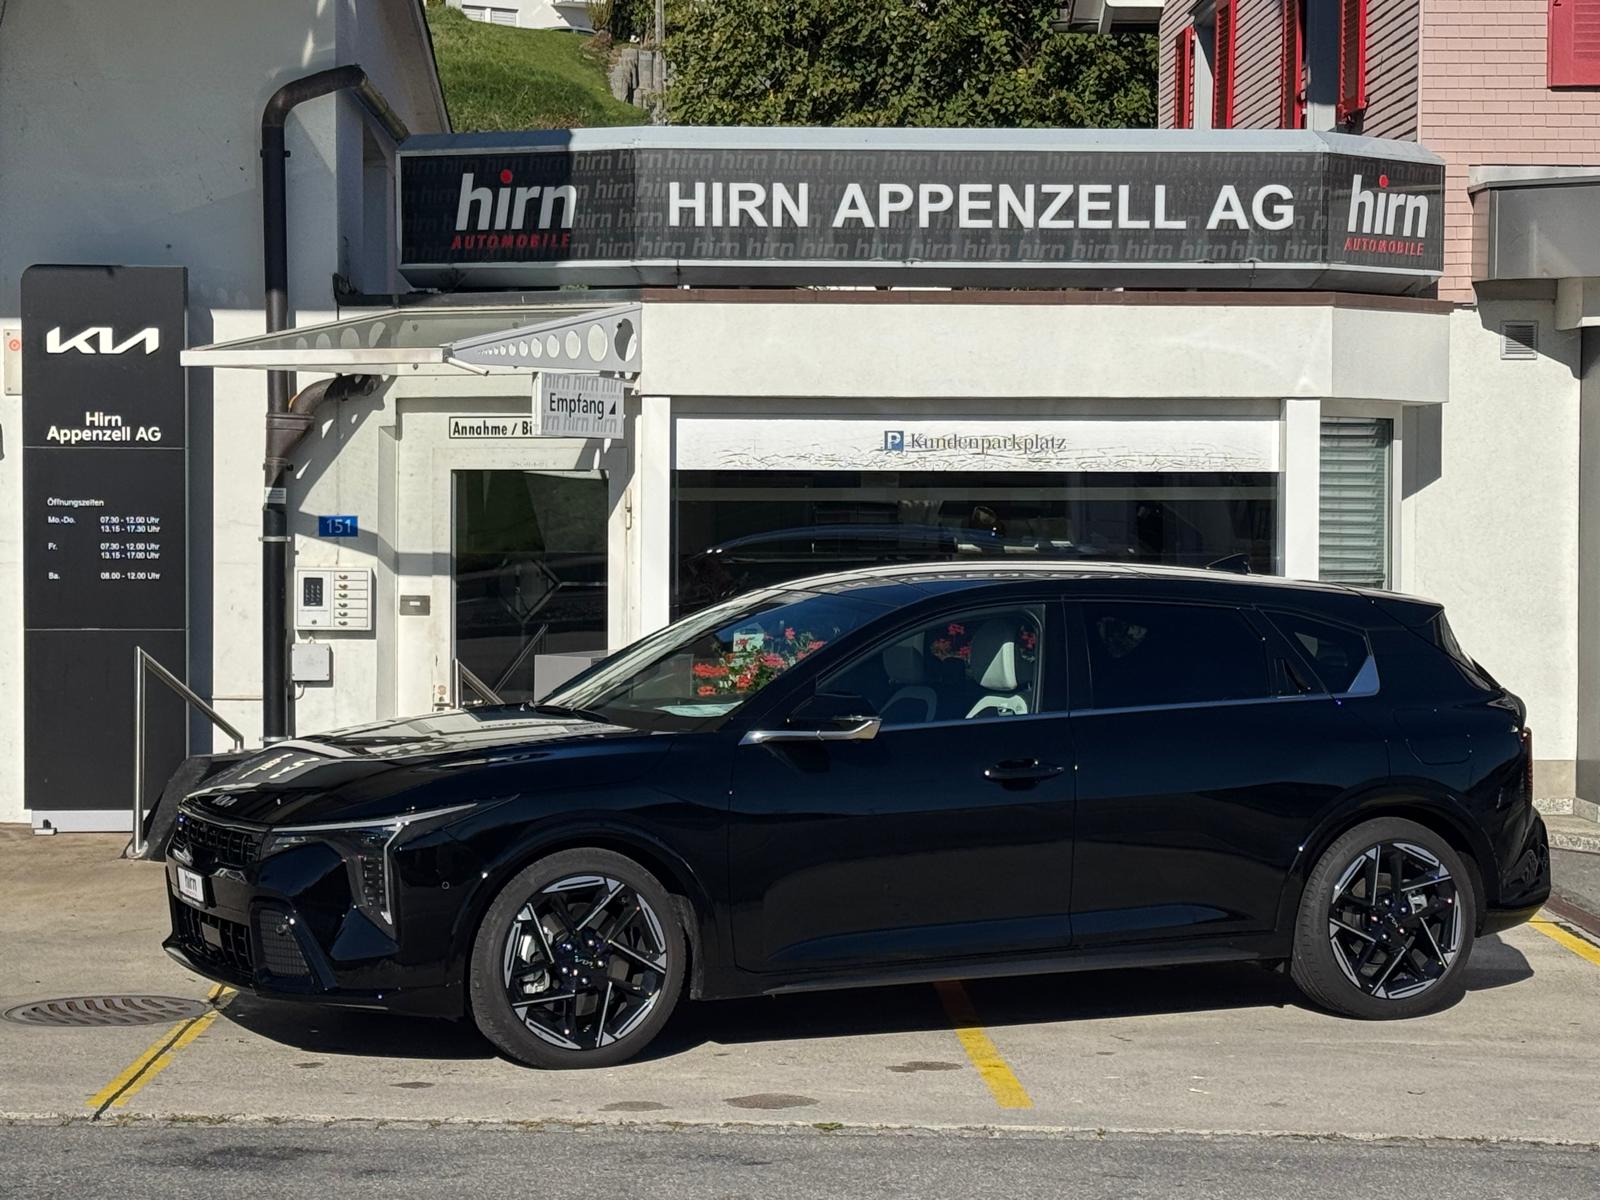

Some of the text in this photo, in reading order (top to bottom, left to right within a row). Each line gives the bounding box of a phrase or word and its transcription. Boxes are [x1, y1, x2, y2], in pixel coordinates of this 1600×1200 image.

[720, 151, 769, 169] hirn
[775, 151, 824, 169] hirn
[455, 169, 577, 231] hirn
[668, 181, 809, 228] HIRN
[832, 182, 1188, 230] APPENZELL
[1205, 184, 1295, 231] AG
[1347, 174, 1429, 238] hirn
[451, 232, 570, 250] AUTOMOBILE
[692, 238, 740, 258] hirn
[746, 238, 795, 258] hirn
[801, 238, 849, 258] hirn
[910, 238, 958, 259] hirn
[1017, 238, 1065, 259] hirn
[1072, 239, 1120, 260] hirn
[1125, 239, 1174, 260] hirn
[1344, 237, 1425, 257] AUTOMOBILE
[549, 392, 604, 420] Empfang
[85, 411, 122, 427] Hirn
[46, 426, 162, 443] Appenzell AG
[452, 420, 508, 436] Annahme
[910, 432, 1067, 455] Kundenparkplatz
[47, 497, 104, 508] Öffnungszeiten
[100, 516, 120, 524] 07.30
[125, 516, 145, 524] 12.00
[146, 516, 160, 524] Uhr
[326, 519, 352, 534] 151
[101, 525, 120, 533] 13.15
[126, 525, 146, 533] 17.30
[147, 525, 160, 533] Uhr
[100, 542, 120, 550] 07.30
[126, 542, 145, 550] 12.00
[146, 542, 160, 550] Uhr
[101, 551, 120, 559] 13.15
[126, 551, 146, 559] 17.00
[146, 551, 160, 559] Uhr
[100, 572, 121, 580] 08.00
[127, 572, 146, 580] 12.00
[147, 572, 160, 580] Uhr
